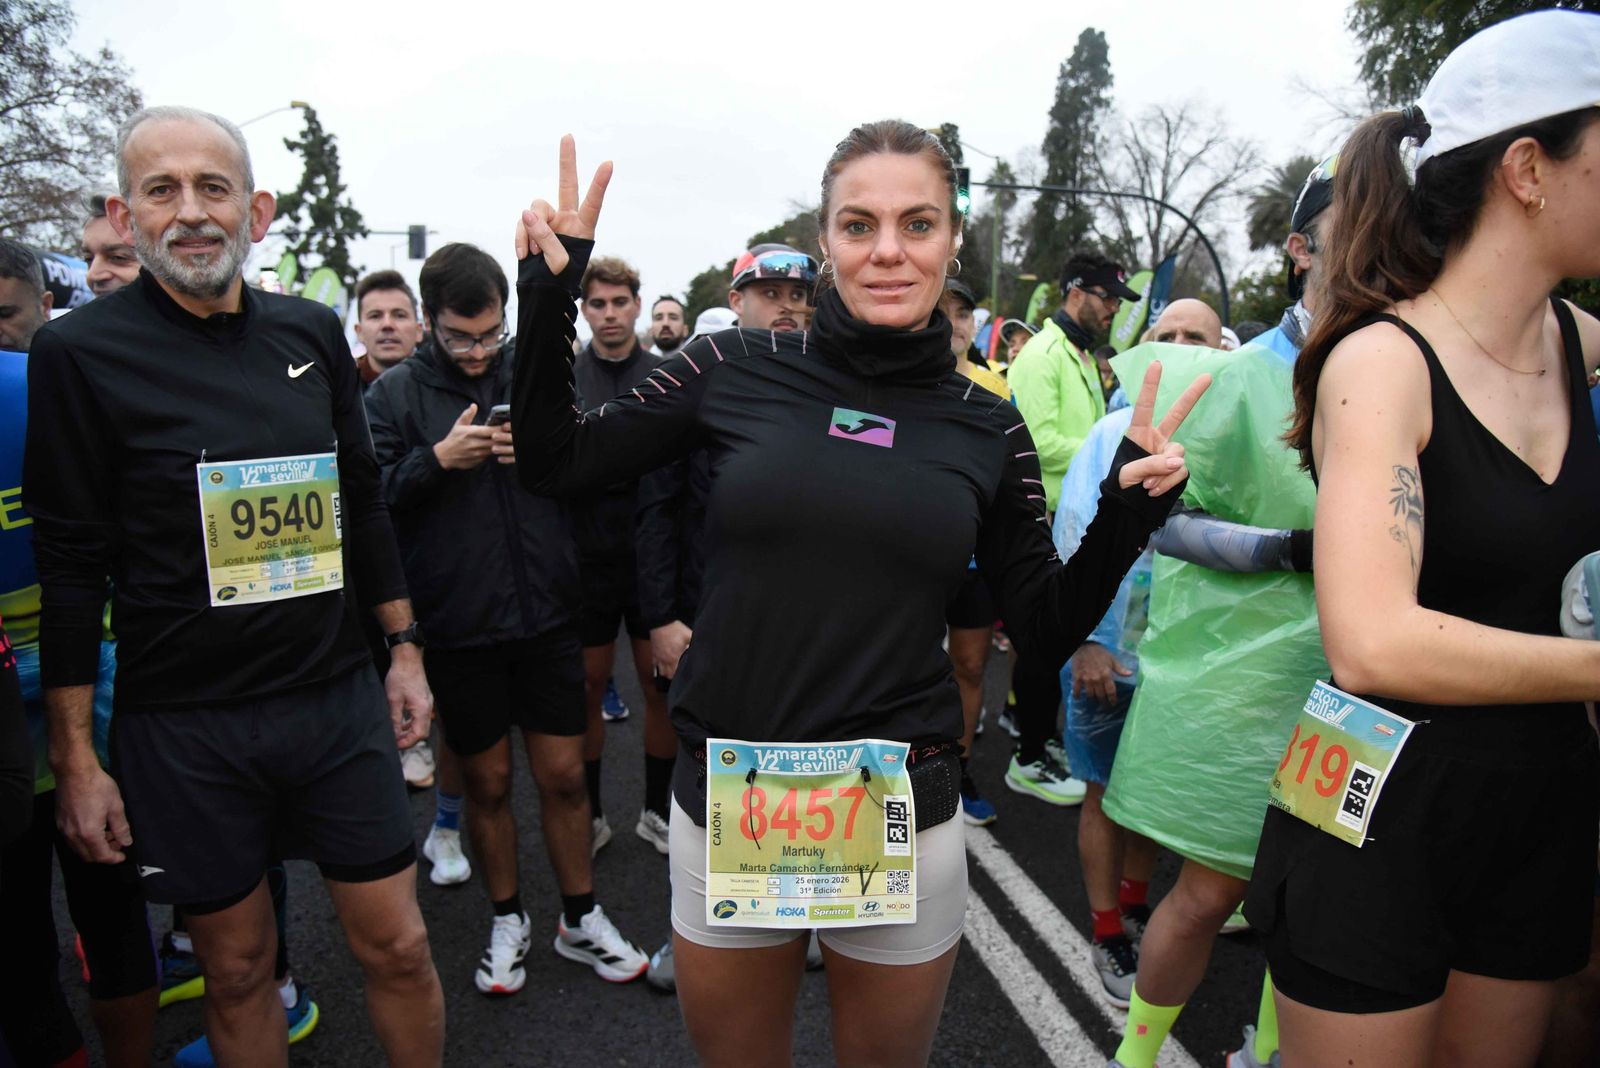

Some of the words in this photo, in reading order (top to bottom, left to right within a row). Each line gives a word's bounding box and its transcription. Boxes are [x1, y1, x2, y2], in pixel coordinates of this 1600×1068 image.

[258, 460, 308, 474] maratón
[270, 469, 308, 483] sevilla
[231, 491, 324, 540] 9540
[255, 539, 279, 551] JOSE
[280, 535, 312, 546] MANUEL
[247, 552, 282, 563] MANUEL
[270, 582, 293, 592] HOKA
[777, 747, 847, 760] maratón
[793, 757, 847, 772] sevilla
[740, 786, 866, 841] 8457
[711, 811, 722, 846] CAJÓN
[782, 845, 825, 859] Martuky
[740, 863, 767, 872] Marta
[769, 863, 816, 873] Camacho
[819, 862, 870, 873] Fernández
[831, 876, 850, 884] 2026
[813, 886, 842, 894] Edición
[776, 907, 806, 917] HOKA
[814, 908, 850, 917] Sprinter
